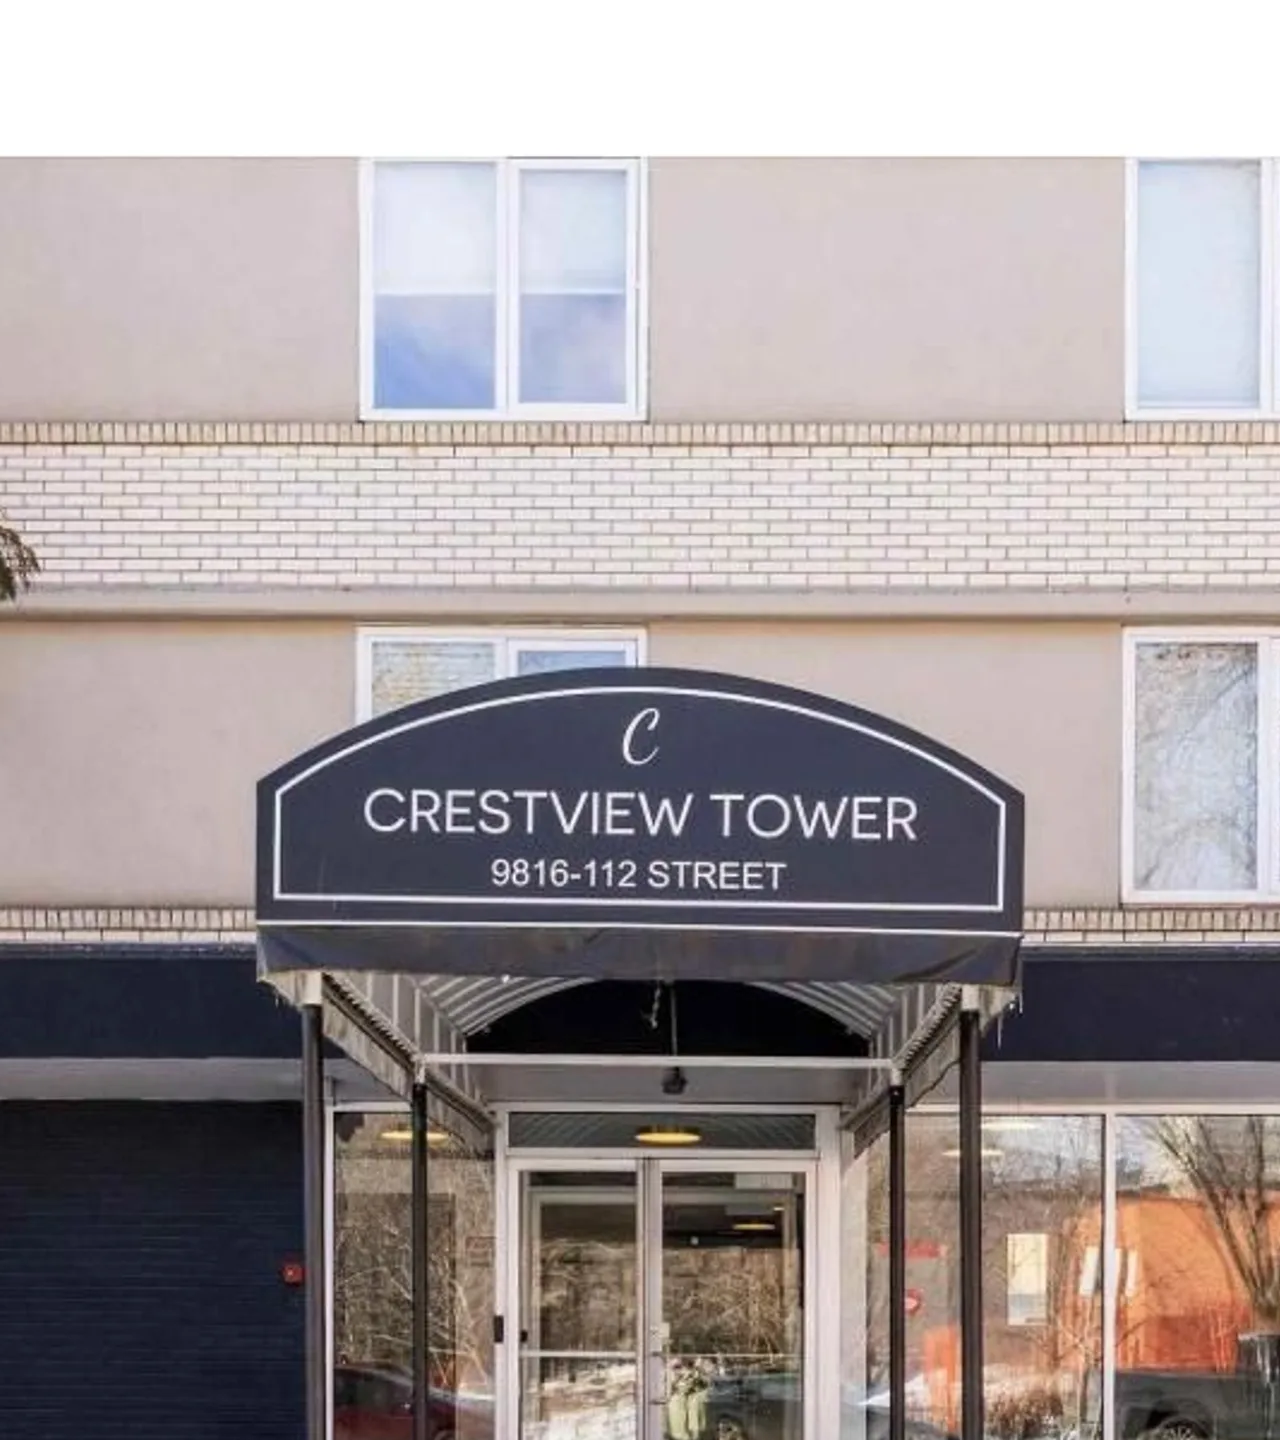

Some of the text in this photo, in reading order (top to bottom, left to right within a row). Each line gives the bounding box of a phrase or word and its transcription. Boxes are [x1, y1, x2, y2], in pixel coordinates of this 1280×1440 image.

[622, 707, 661, 766] C
[363, 787, 918, 841] CRESTVIEW TOWER
[491, 858, 788, 891] 9816-112 STREET
